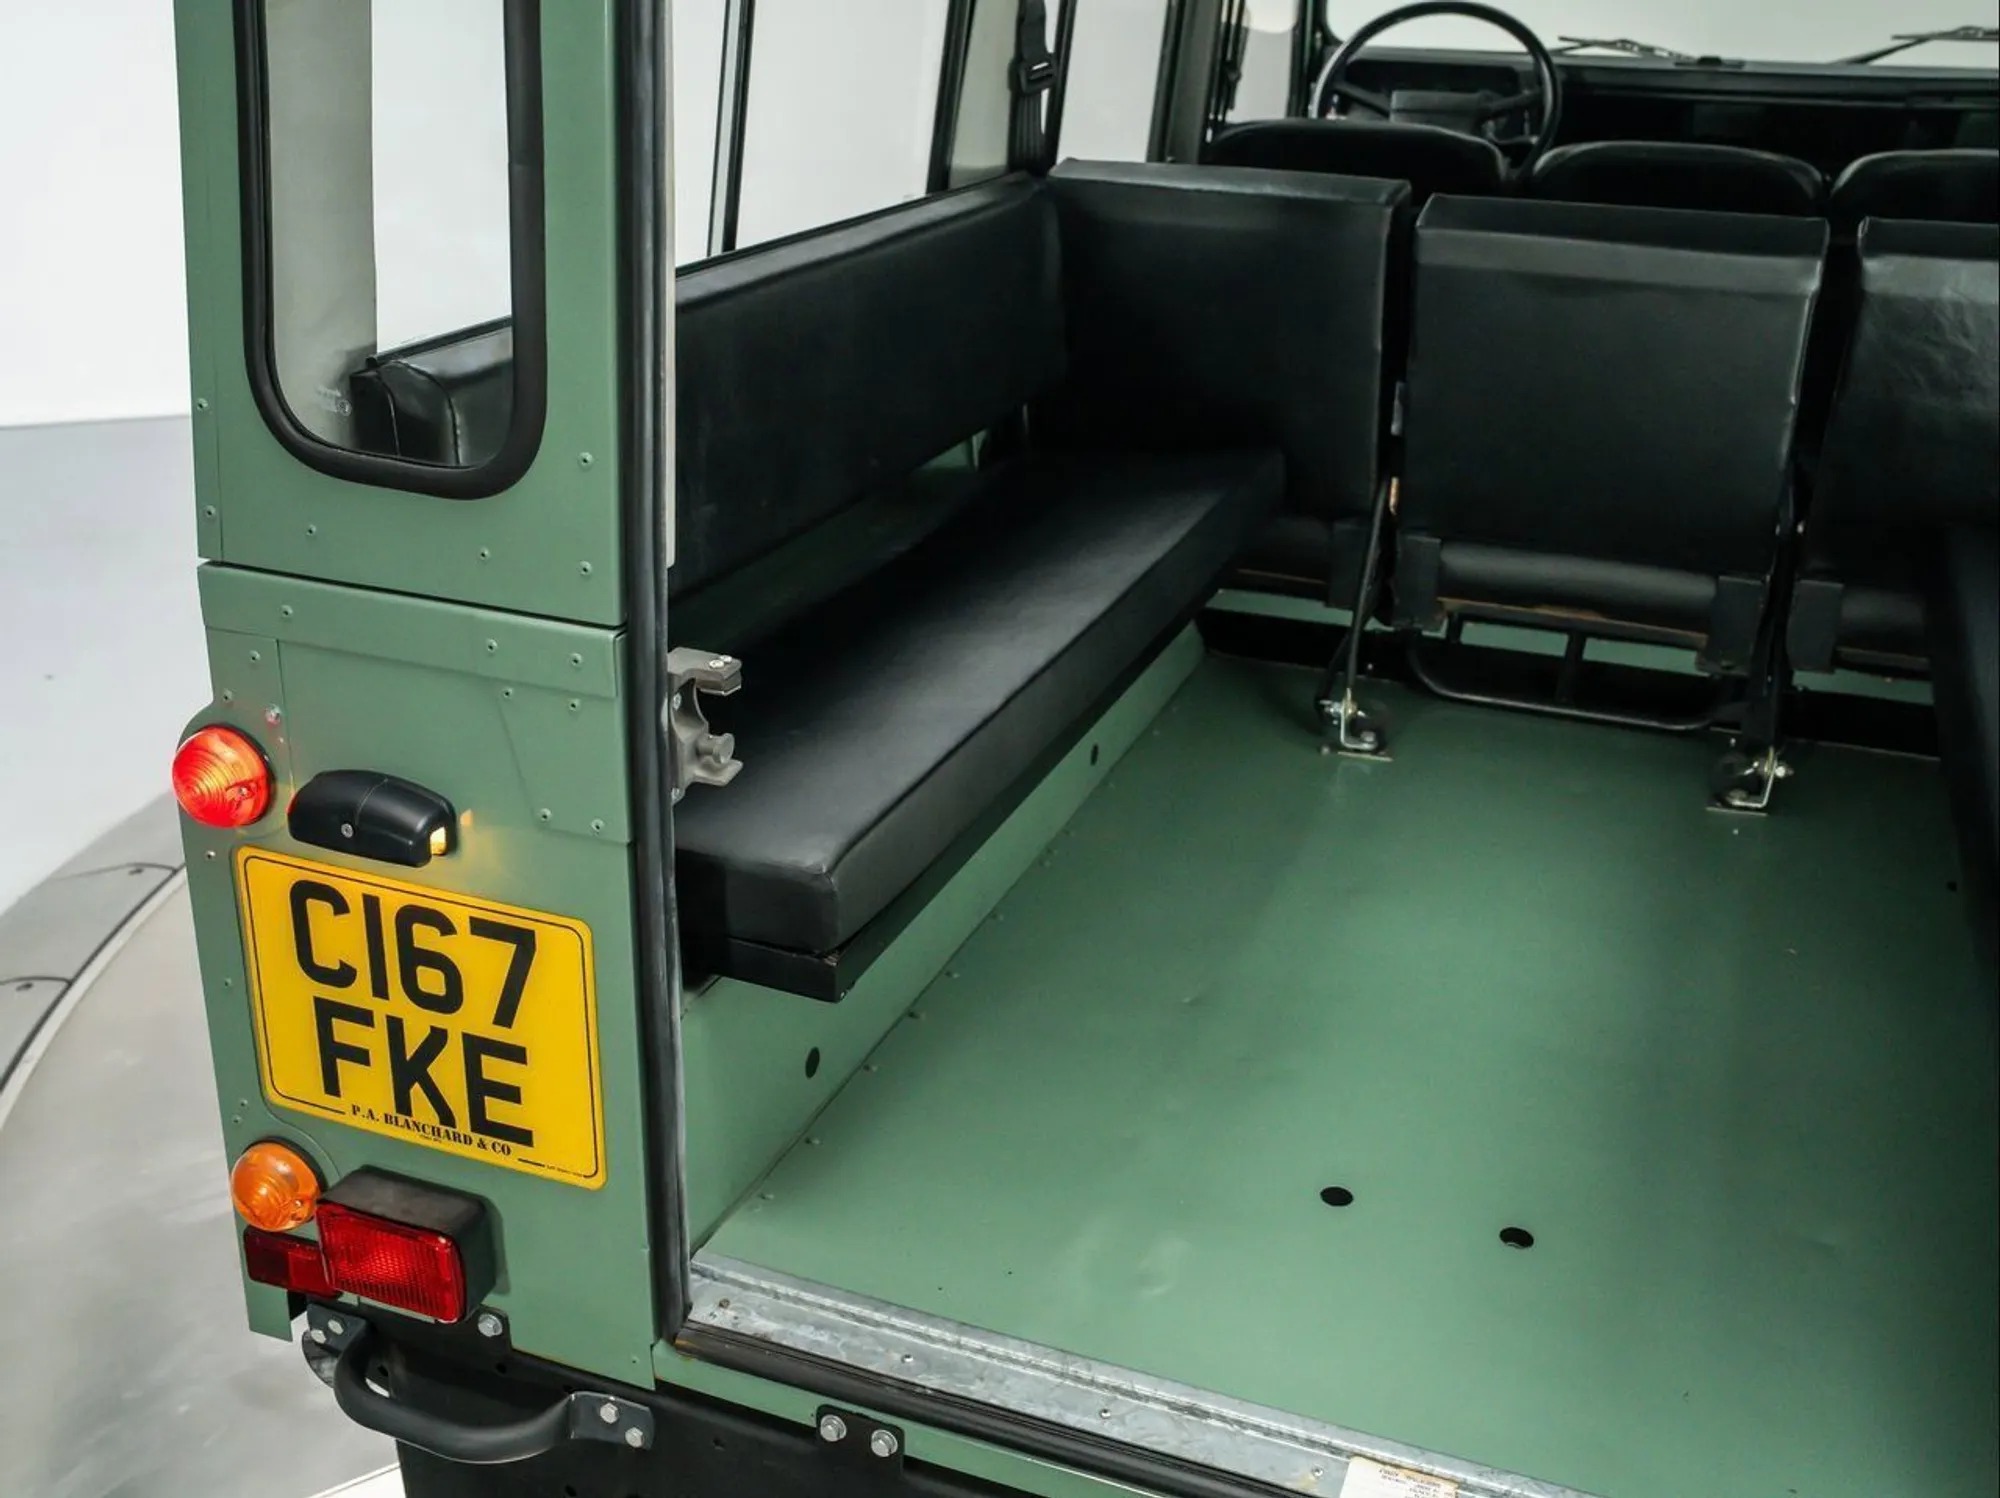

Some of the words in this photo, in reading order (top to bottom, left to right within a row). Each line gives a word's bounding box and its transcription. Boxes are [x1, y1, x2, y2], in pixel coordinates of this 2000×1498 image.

[290, 880, 537, 1029] C167
[313, 996, 534, 1148] FKE
[384, 1113, 473, 1146] BLANCHARD
[477, 1137, 489, 1152] &
[491, 1142, 512, 1157] CO
